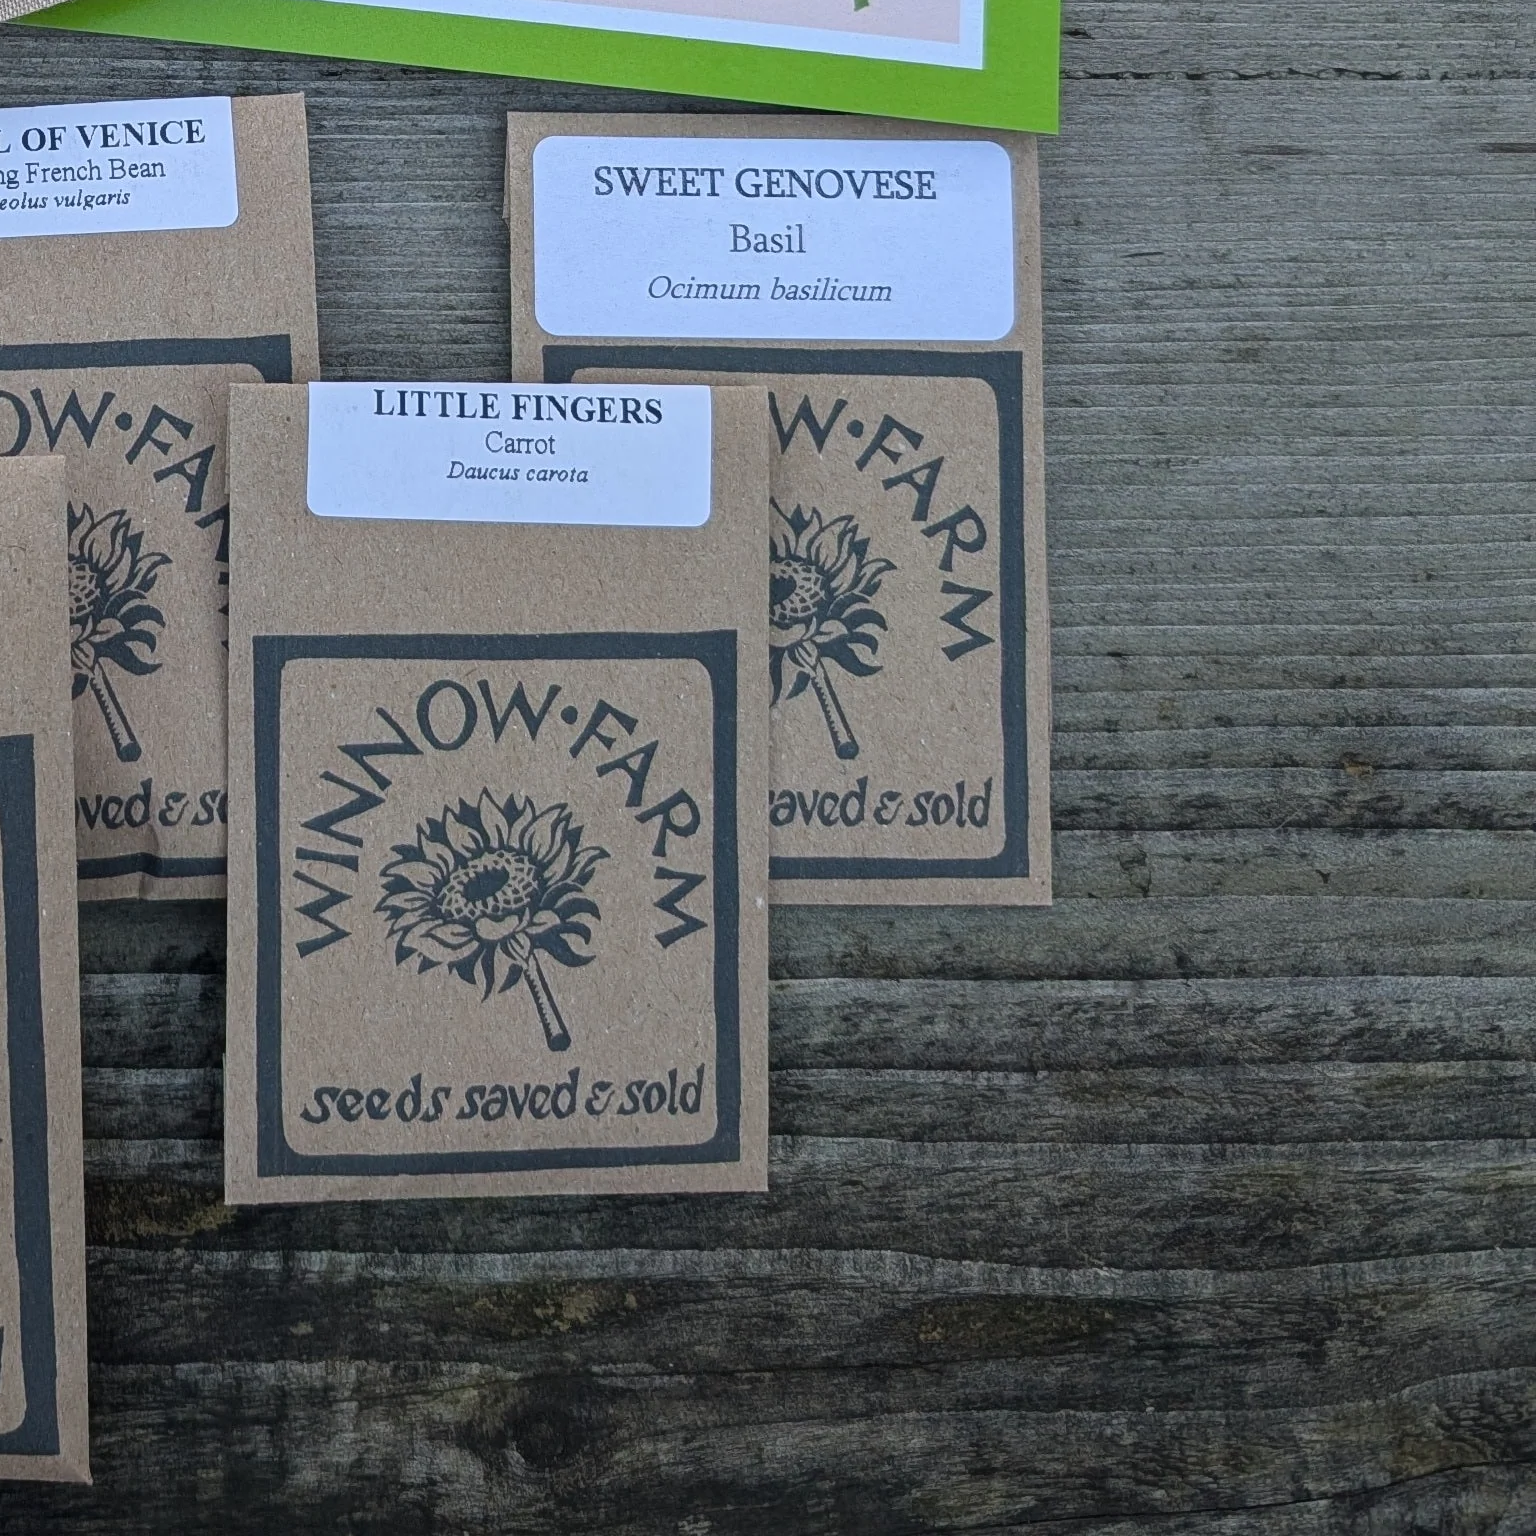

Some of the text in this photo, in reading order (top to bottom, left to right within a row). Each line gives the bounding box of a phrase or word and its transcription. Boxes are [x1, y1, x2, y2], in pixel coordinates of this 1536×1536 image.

[21, 126, 67, 152] OF
[75, 119, 206, 148] VENICE
[25, 159, 102, 184] French
[109, 159, 167, 180] Bean
[593, 165, 938, 200] SWEET GENOVESE
[53, 189, 131, 211] vulgaris
[728, 223, 807, 254] Basil
[647, 275, 893, 302] Ocimum basilicum
[373, 388, 663, 425] LITTLE FINGERS
[484, 430, 556, 455] Carrot
[446, 461, 589, 483] Daucus carota
[75, 778, 153, 829] ved
[159, 791, 190, 827] &
[768, 776, 993, 828] aved & sold
[300, 1062, 706, 1124] seeds saved & sold
